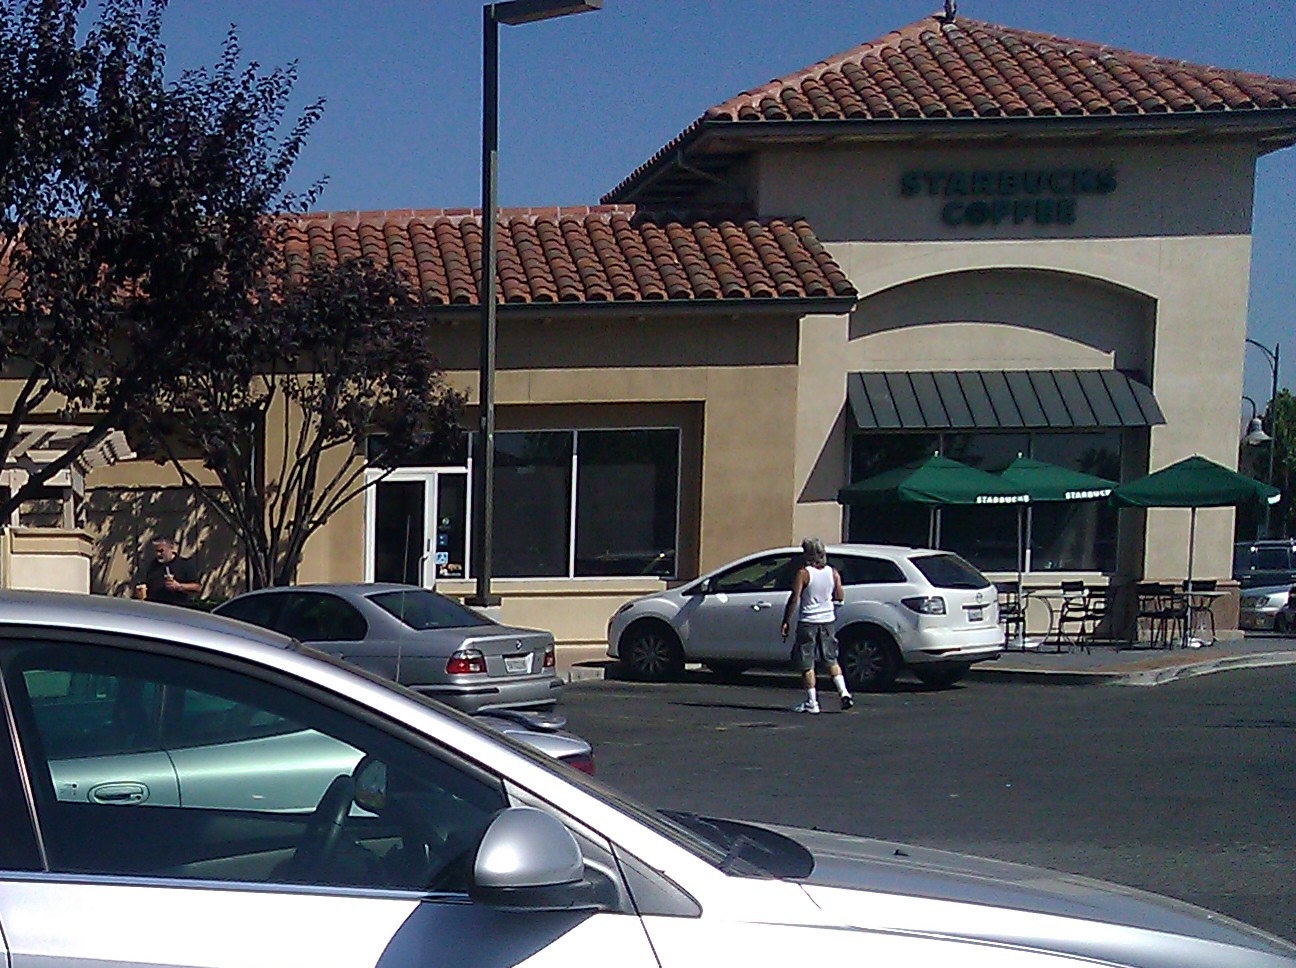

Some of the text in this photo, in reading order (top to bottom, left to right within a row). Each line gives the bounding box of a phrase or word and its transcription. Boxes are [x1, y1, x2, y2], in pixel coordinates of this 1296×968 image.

[901, 169, 1118, 196] STARBUCKS
[941, 200, 1077, 225] COFFEE
[976, 494, 1029, 504] STARBUCKS
